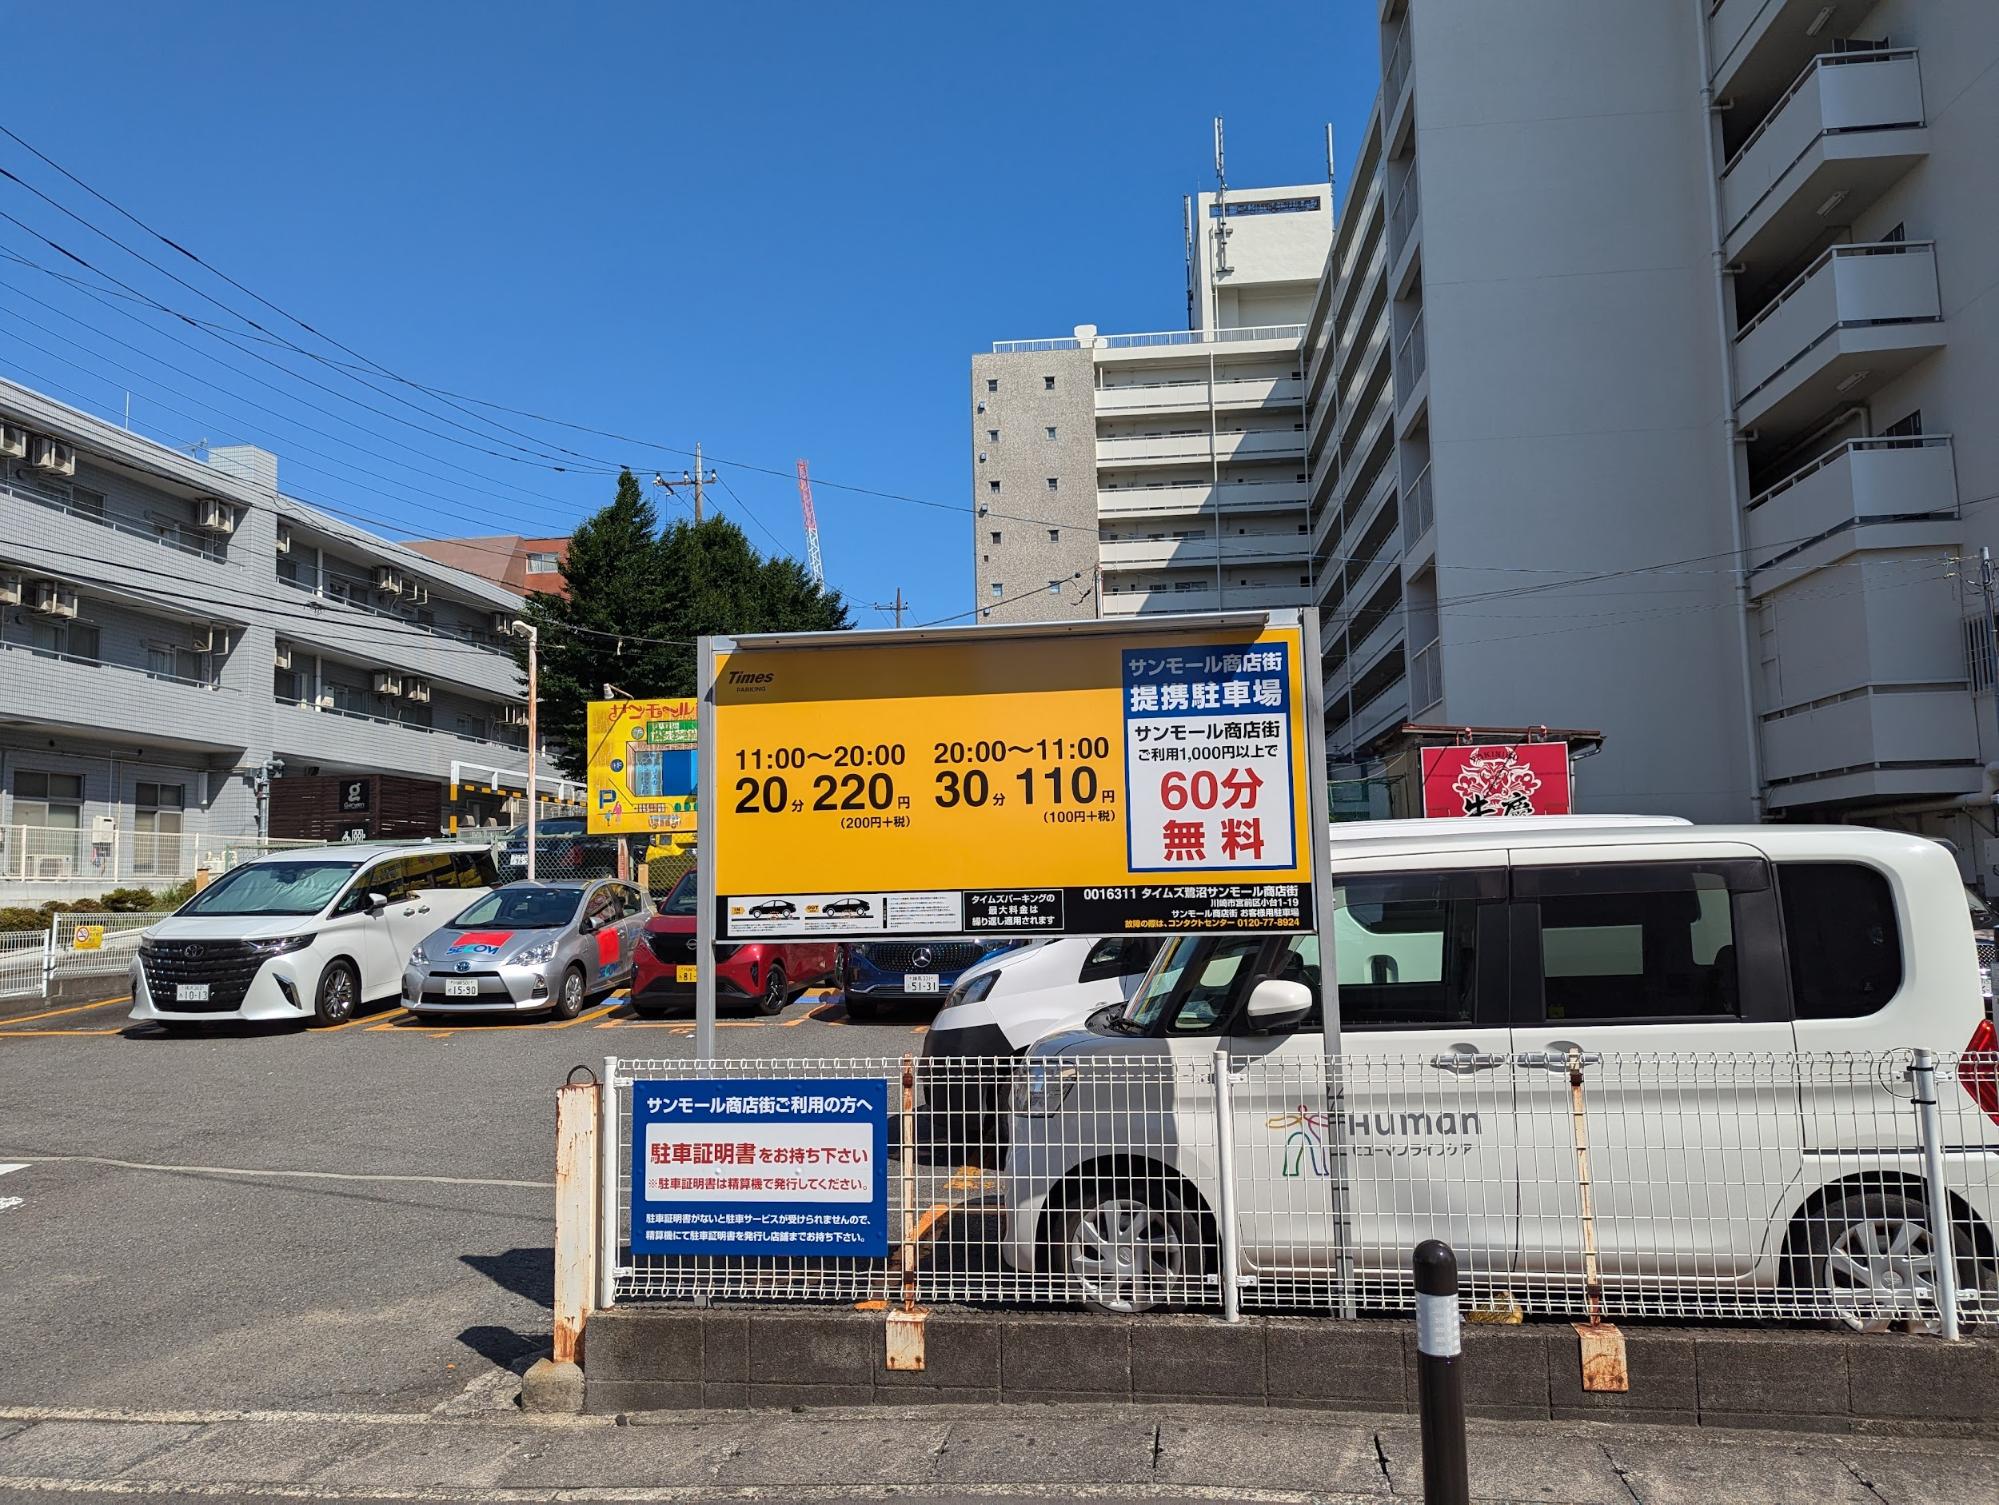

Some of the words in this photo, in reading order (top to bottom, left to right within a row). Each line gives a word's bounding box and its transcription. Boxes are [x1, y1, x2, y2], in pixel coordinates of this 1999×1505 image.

[1128, 651, 1282, 676] サンモール商店街
[728, 670, 775, 684] Times
[1130, 679, 1282, 712] 提携駐車場
[608, 702, 697, 721] サンモール
[1134, 720, 1280, 742] サンモール商店街
[1137, 744, 1279, 763] ご利用1,000円以上で
[1160, 767, 1264, 810] 60分
[599, 789, 617, 810] P
[1162, 817, 1265, 862] 無料
[971, 893, 1055, 905] タイムズパーキングの
[1083, 888, 1137, 900] 0016311
[988, 905, 1038, 915] 最大料金は
[1171, 908, 1238, 918] サンモール商店街
[971, 916, 1055, 926] 繰り返し適用されます
[1237, 917, 1300, 927] 0120-77-8924
[912, 981, 936, 991] 51-31
[646, 1096, 873, 1114] サンモール商店街ご利用の方へ
[1350, 1112, 1482, 1136] Human
[650, 1143, 868, 1165] 駐車証明書をお持ち下さい
[645, 1213, 871, 1225] 駐車証明書がないと駐車サービスが受けられませんので、
[645, 1230, 865, 1242] 精算機にて駐車証明書を発行し店舗までお持ち下さい。
